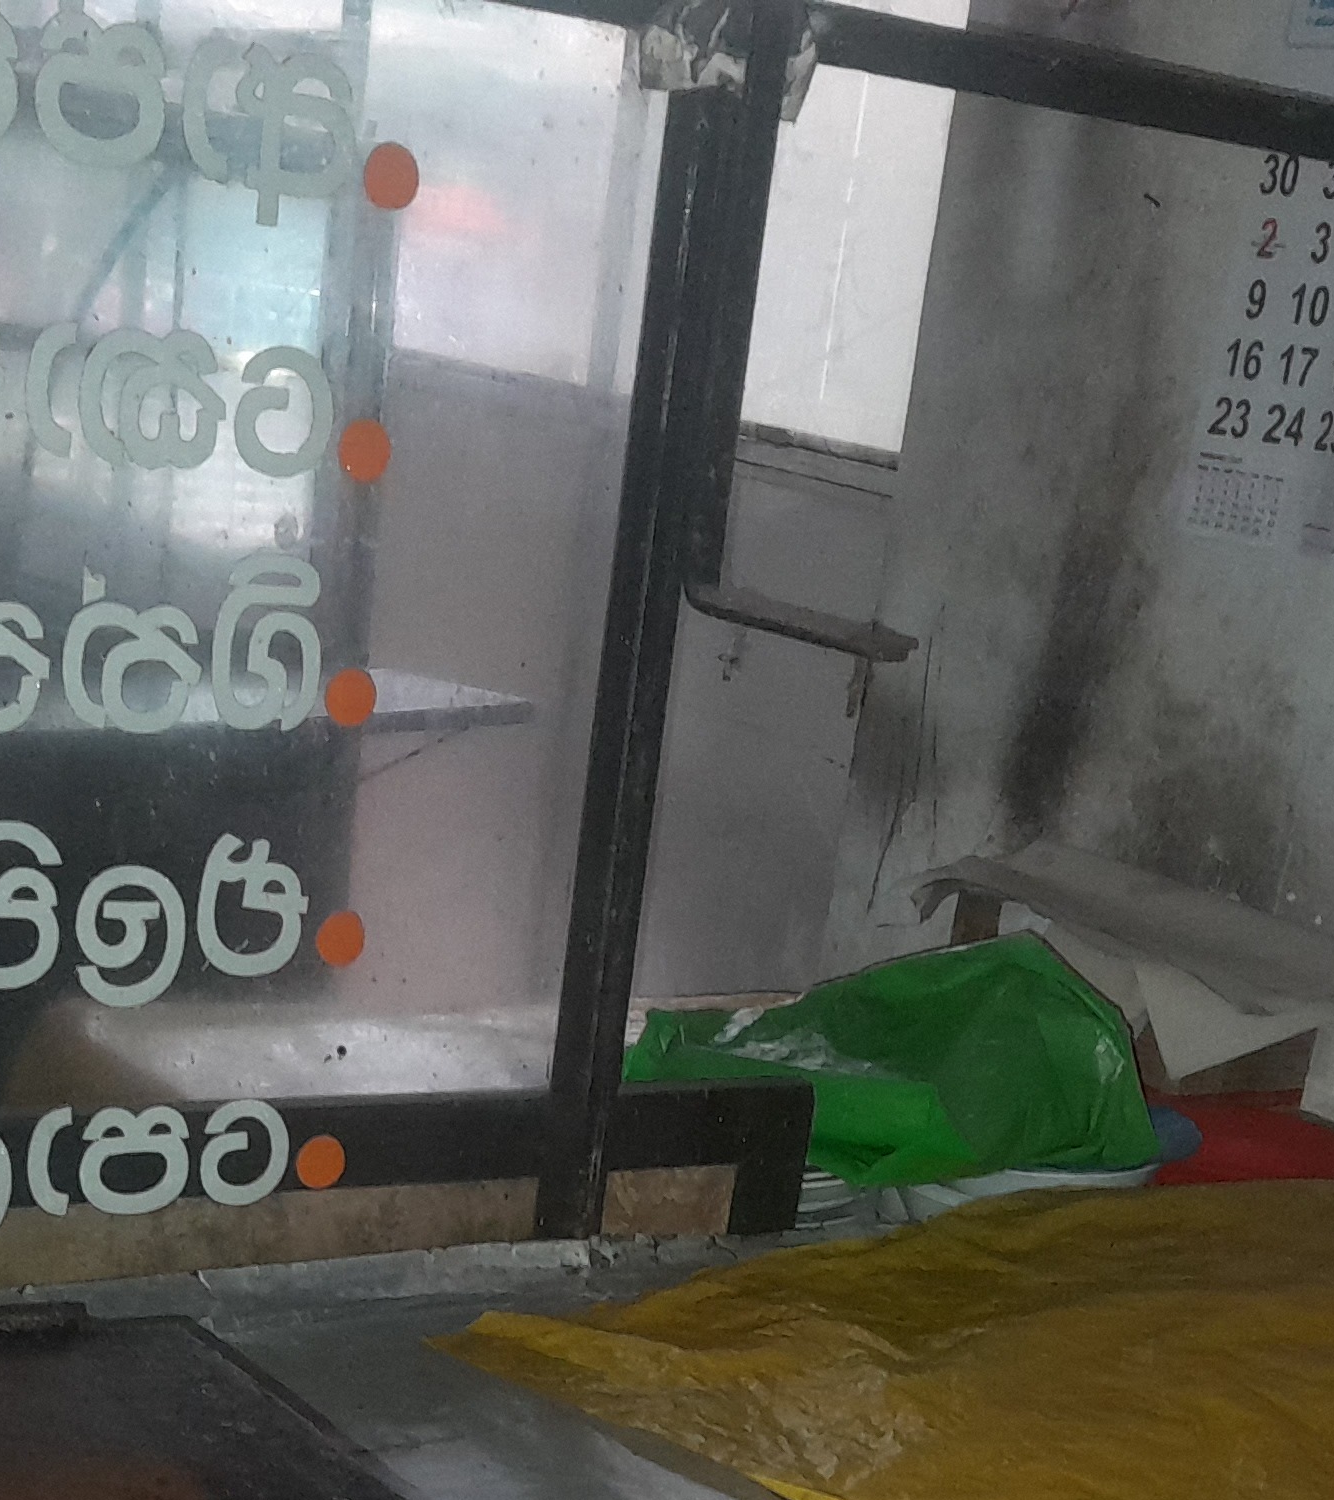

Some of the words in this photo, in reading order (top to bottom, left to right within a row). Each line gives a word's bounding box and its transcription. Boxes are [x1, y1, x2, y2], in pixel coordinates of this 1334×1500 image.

[1260, 153, 1299, 197] 30
[1257, 217, 1278, 259] 2
[1310, 221, 1332, 264] 3
[1245, 279, 1266, 320] 9
[1292, 283, 1329, 327] 10
[1227, 338, 1264, 381] 16
[1280, 344, 1319, 387] 17
[1208, 397, 1251, 440] 23
[1262, 404, 1306, 446] 24
